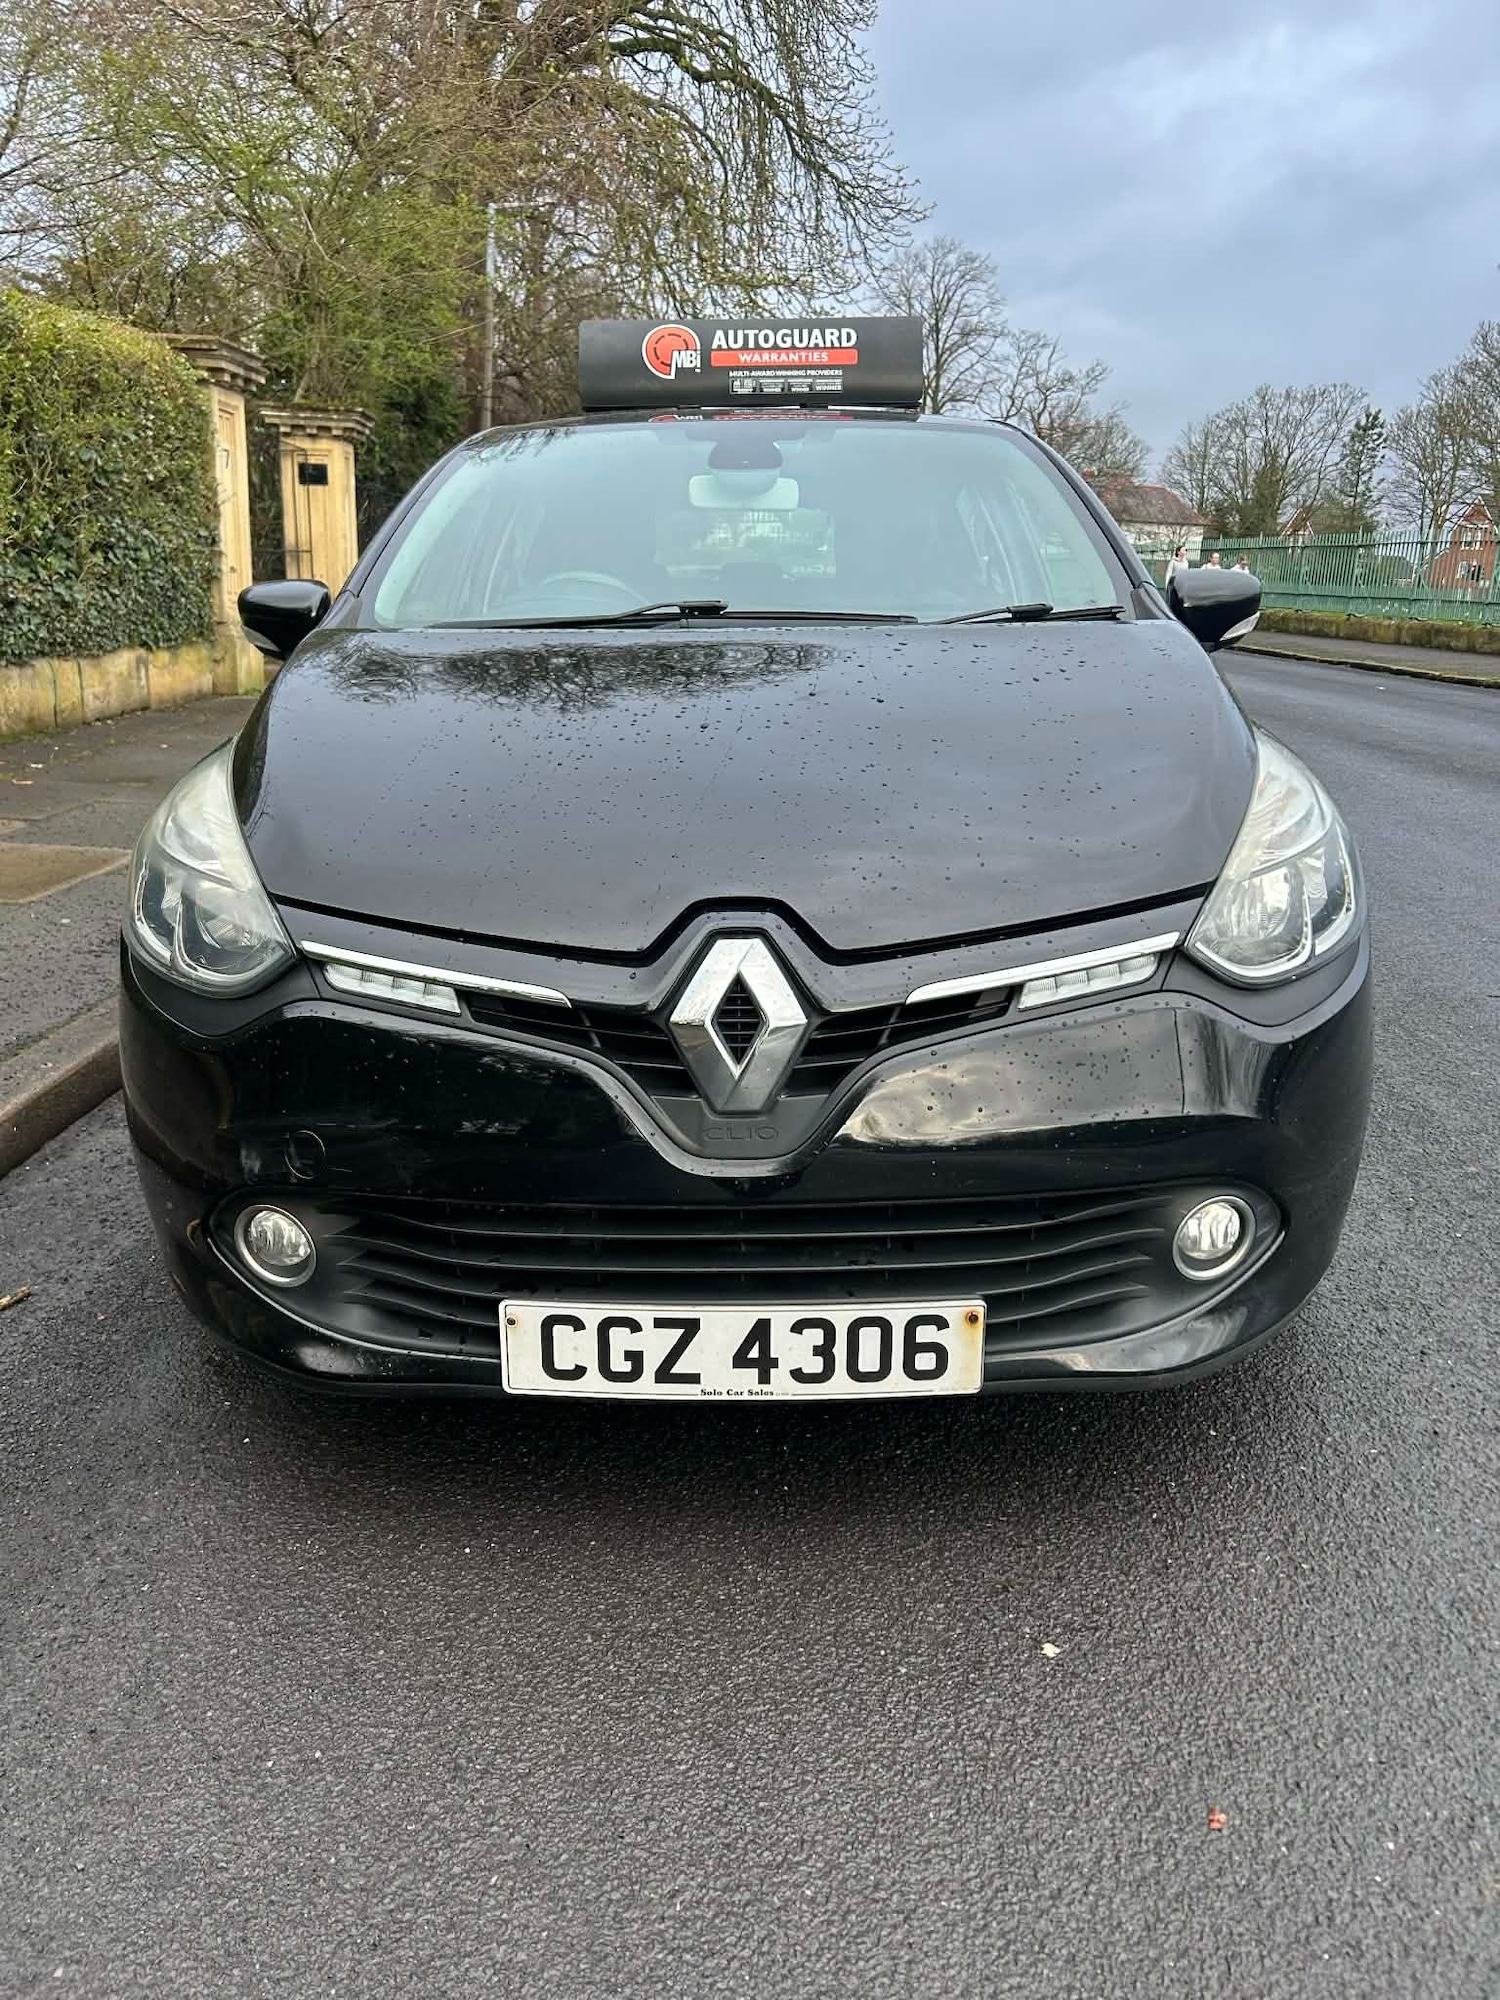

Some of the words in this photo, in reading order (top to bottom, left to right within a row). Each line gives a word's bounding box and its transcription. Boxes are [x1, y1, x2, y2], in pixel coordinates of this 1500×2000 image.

[711, 328, 858, 349] AUTOGUARD
[738, 351, 829, 364] WARRANTIES
[703, 1126, 779, 1140] CLIO
[540, 1313, 701, 1385] CGZ
[732, 1313, 950, 1386] 4306
[700, 1389, 723, 1397] Solo
[726, 1389, 745, 1397] Car
[747, 1389, 774, 1397] Sales
